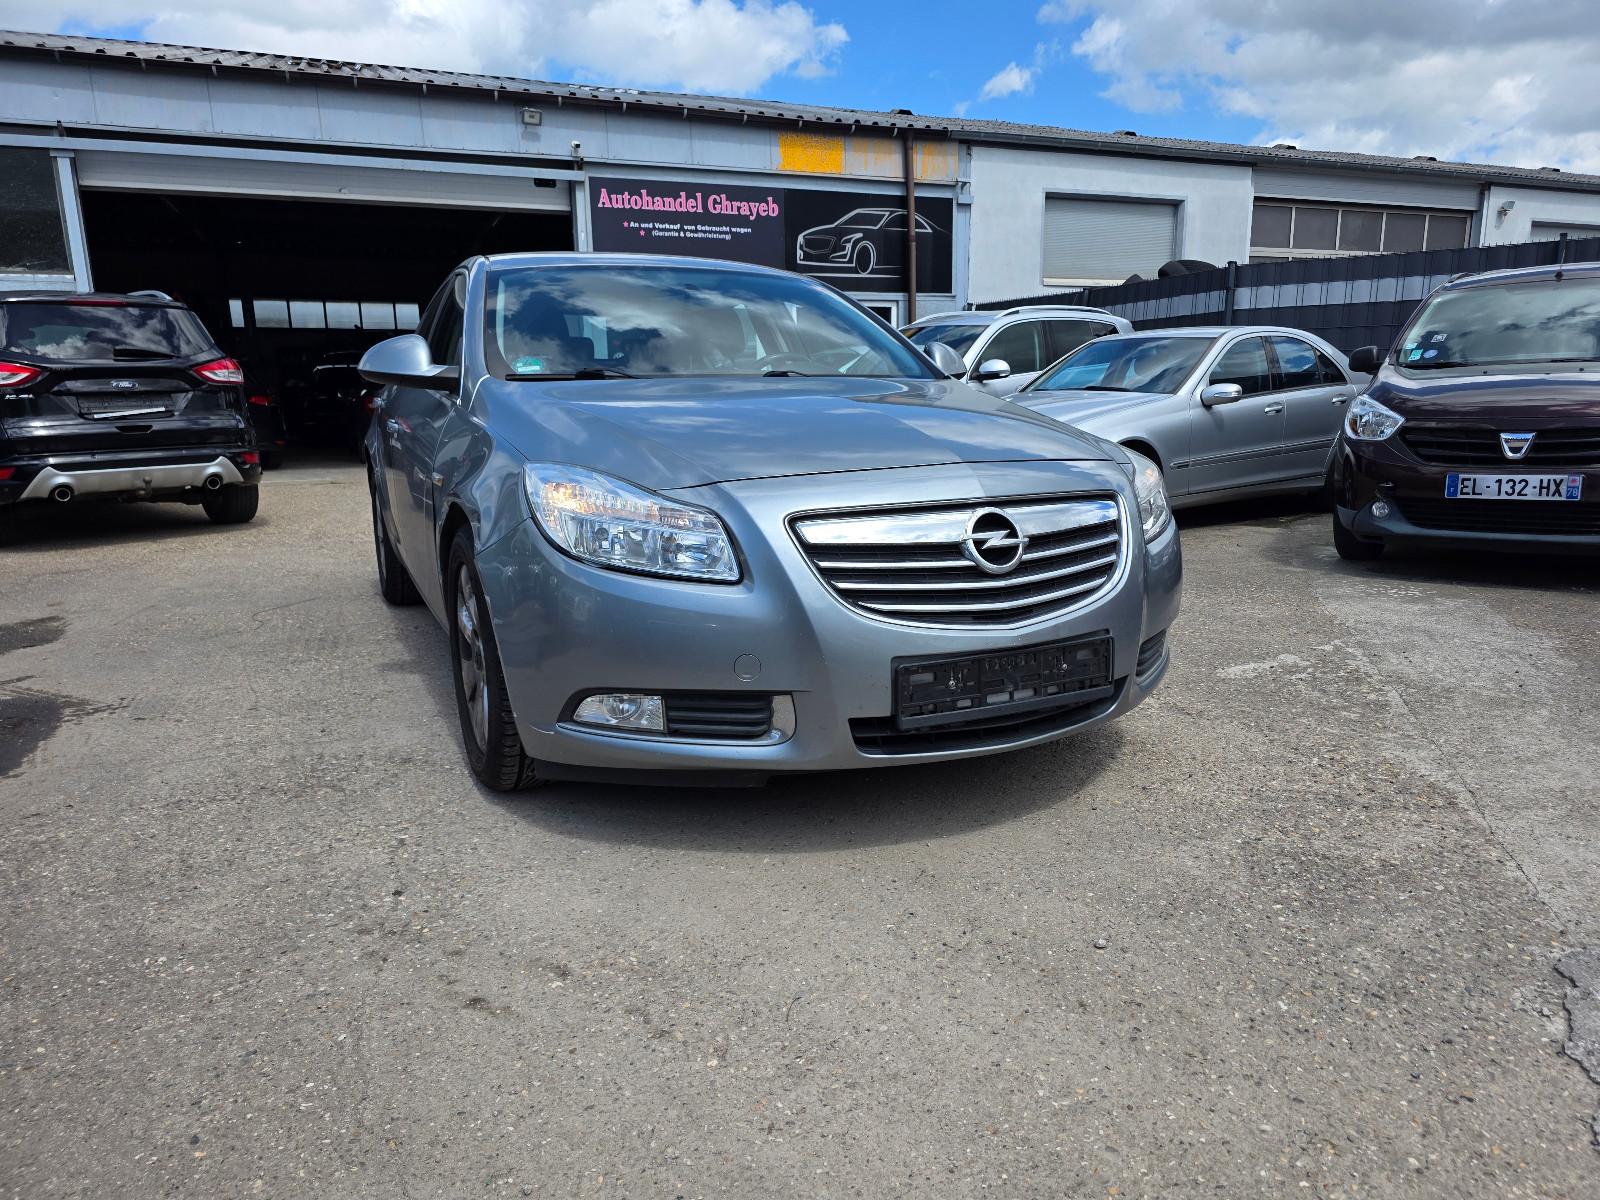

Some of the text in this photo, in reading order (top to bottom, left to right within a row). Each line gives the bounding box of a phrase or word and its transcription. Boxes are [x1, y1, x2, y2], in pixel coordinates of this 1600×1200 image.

[598, 188, 779, 220] Autohandel Ghrayeb
[1567, 488, 1578, 496] 78
